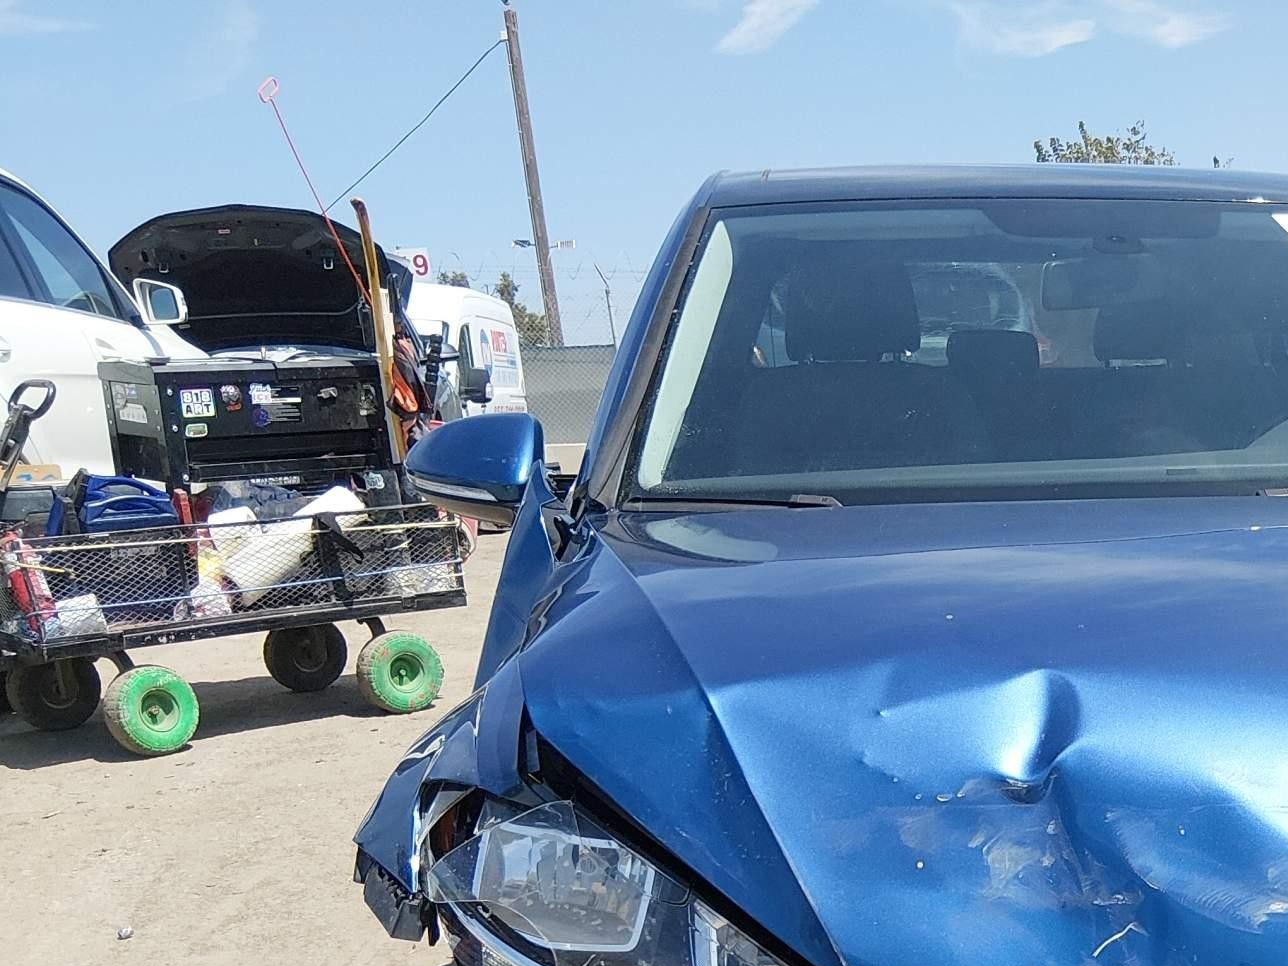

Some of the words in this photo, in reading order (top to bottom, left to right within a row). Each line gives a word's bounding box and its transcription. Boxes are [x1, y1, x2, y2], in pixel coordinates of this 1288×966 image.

[412, 254, 429, 276] 9
[182, 390, 211, 403] 818
[184, 403, 213, 416] ART
